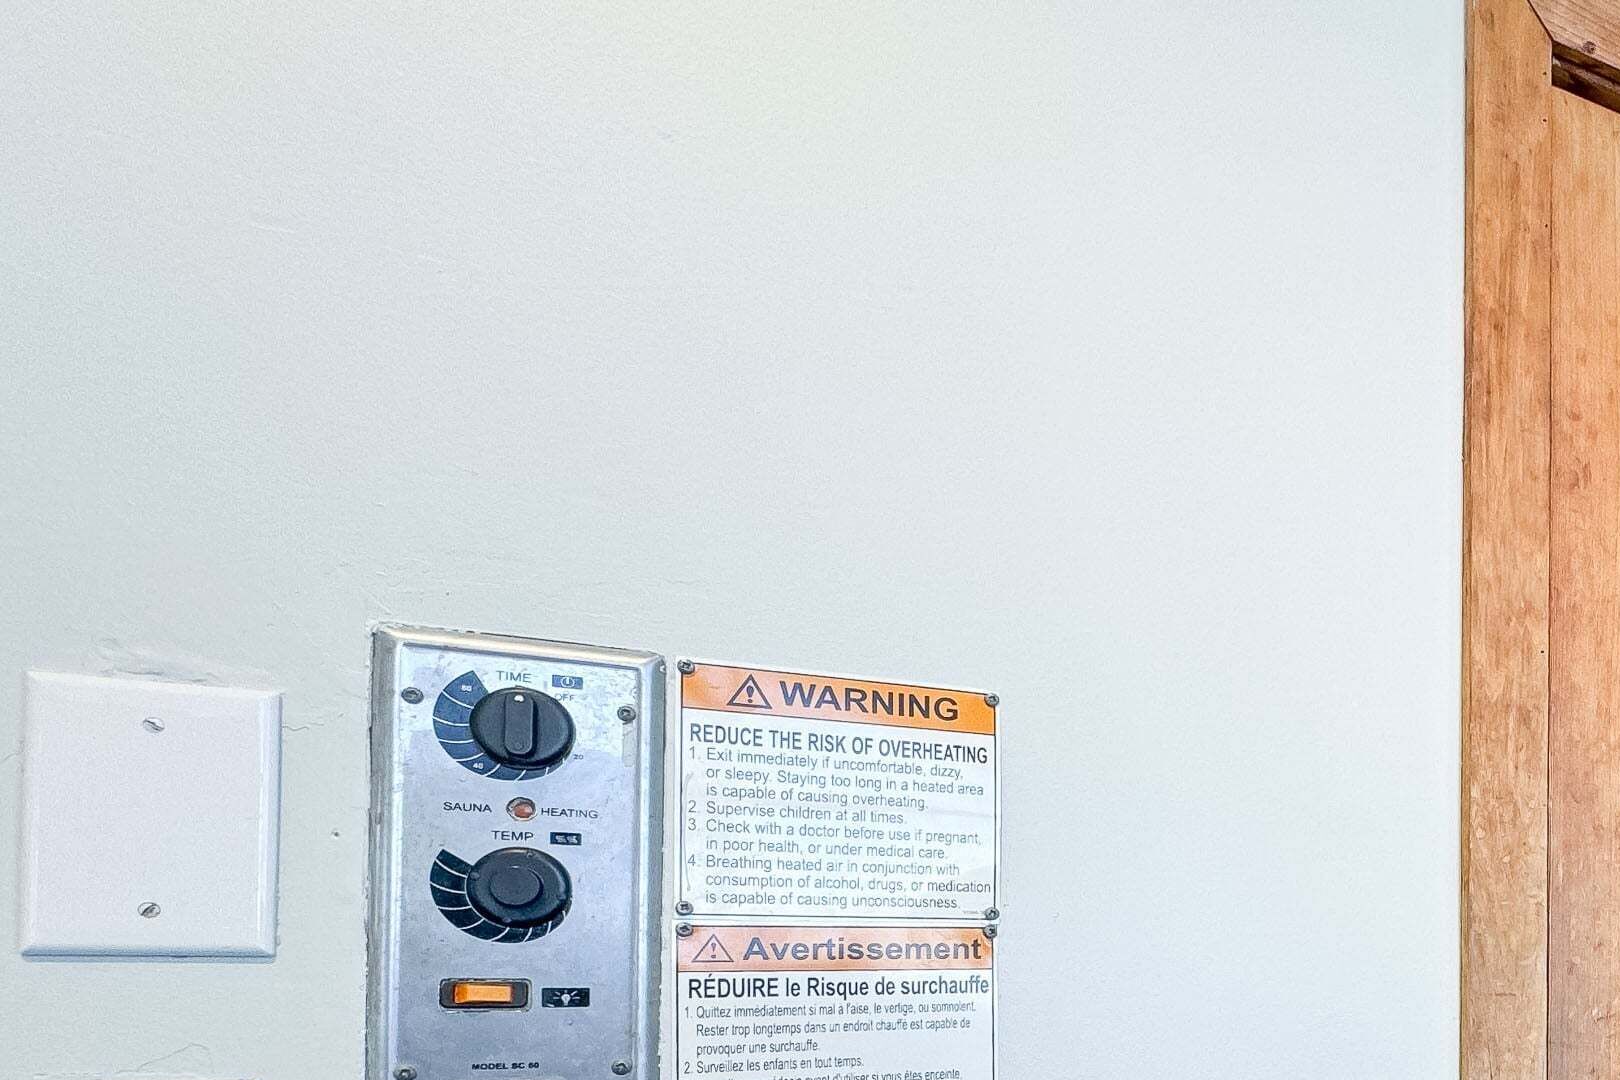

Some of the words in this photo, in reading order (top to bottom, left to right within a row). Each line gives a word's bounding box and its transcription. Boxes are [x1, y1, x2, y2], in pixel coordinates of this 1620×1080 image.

[496, 670, 532, 683] TIME
[554, 693, 576, 702] OFF
[780, 680, 958, 721] WARNING
[690, 723, 762, 747] REDUCE
[769, 730, 801, 750] THE
[808, 733, 845, 753] RISK
[852, 736, 873, 755] OF
[879, 739, 987, 764] OVERHEATING
[707, 748, 732, 762] Exit
[737, 750, 816, 771] immediately
[822, 756, 829, 768] if
[706, 769, 720, 778] or
[777, 770, 826, 788] Staying
[831, 776, 850, 786] too
[855, 776, 881, 792] long
[886, 778, 896, 789] in
[901, 782, 908, 790] a
[913, 780, 953, 793] heated
[957, 786, 983, 795] area
[706, 784, 717, 796] is
[722, 785, 775, 803] capable
[780, 789, 793, 800] of
[798, 790, 847, 807] causing
[443, 801, 492, 813] SAUNA
[541, 807, 599, 819] HEATING
[706, 802, 775, 820] Supervise
[779, 806, 830, 819] children
[835, 810, 847, 820] at
[852, 810, 865, 821] all
[491, 830, 534, 841] TEMP
[706, 819, 750, 833] Check
[754, 822, 781, 834] with
[787, 826, 794, 835] a
[799, 824, 838, 837] doctor
[844, 826, 883, 839] before
[888, 831, 910, 840] use
[915, 829, 922, 841] if
[706, 838, 717, 849] in
[722, 841, 753, 854] poor
[807, 845, 821, 853] or
[825, 843, 862, 855] under
[866, 845, 913, 857] medical
[706, 855, 771, 873] Breathing
[777, 858, 821, 870] heated
[826, 860, 843, 871] air
[847, 860, 857, 872] in
[862, 861, 931, 877] conjunction
[936, 863, 959, 875] with
[706, 873, 792, 891] consumption
[797, 876, 810, 888] of
[910, 882, 923, 890] or
[927, 880, 990, 892] medication
[705, 892, 716, 903] is
[721, 892, 775, 908] capable
[780, 894, 793, 905] of
[797, 894, 847, 909] causing
[743, 937, 981, 960] Avertissement
[688, 973, 778, 998] RÉDUIRE
[786, 977, 800, 996] le
[807, 977, 868, 1001] Risque
[874, 977, 894, 995] de
[900, 976, 988, 995] surchauffe
[696, 1005, 731, 1018] Quittez
[809, 1003, 816, 1015] si
[819, 1003, 835, 1015] mal
[874, 1002, 881, 1014] le
[918, 1004, 929, 1013] ou
[696, 1024, 728, 1036] Rester
[732, 1024, 750, 1038] trop
[753, 1022, 801, 1037] longtemps
[804, 1021, 825, 1032] dans
[829, 1023, 840, 1032] un
[843, 1020, 872, 1031] endroit
[909, 1019, 922, 1029] est
[925, 1018, 957, 1032] capable
[959, 1017, 970, 1028] de
[696, 1044, 745, 1058] provoquer
[749, 1043, 766, 1052] une
[747, 1059, 760, 1071] les
[763, 1057, 797, 1070] enfants
[801, 1060, 811, 1069] en
[815, 1057, 832, 1068] tout
